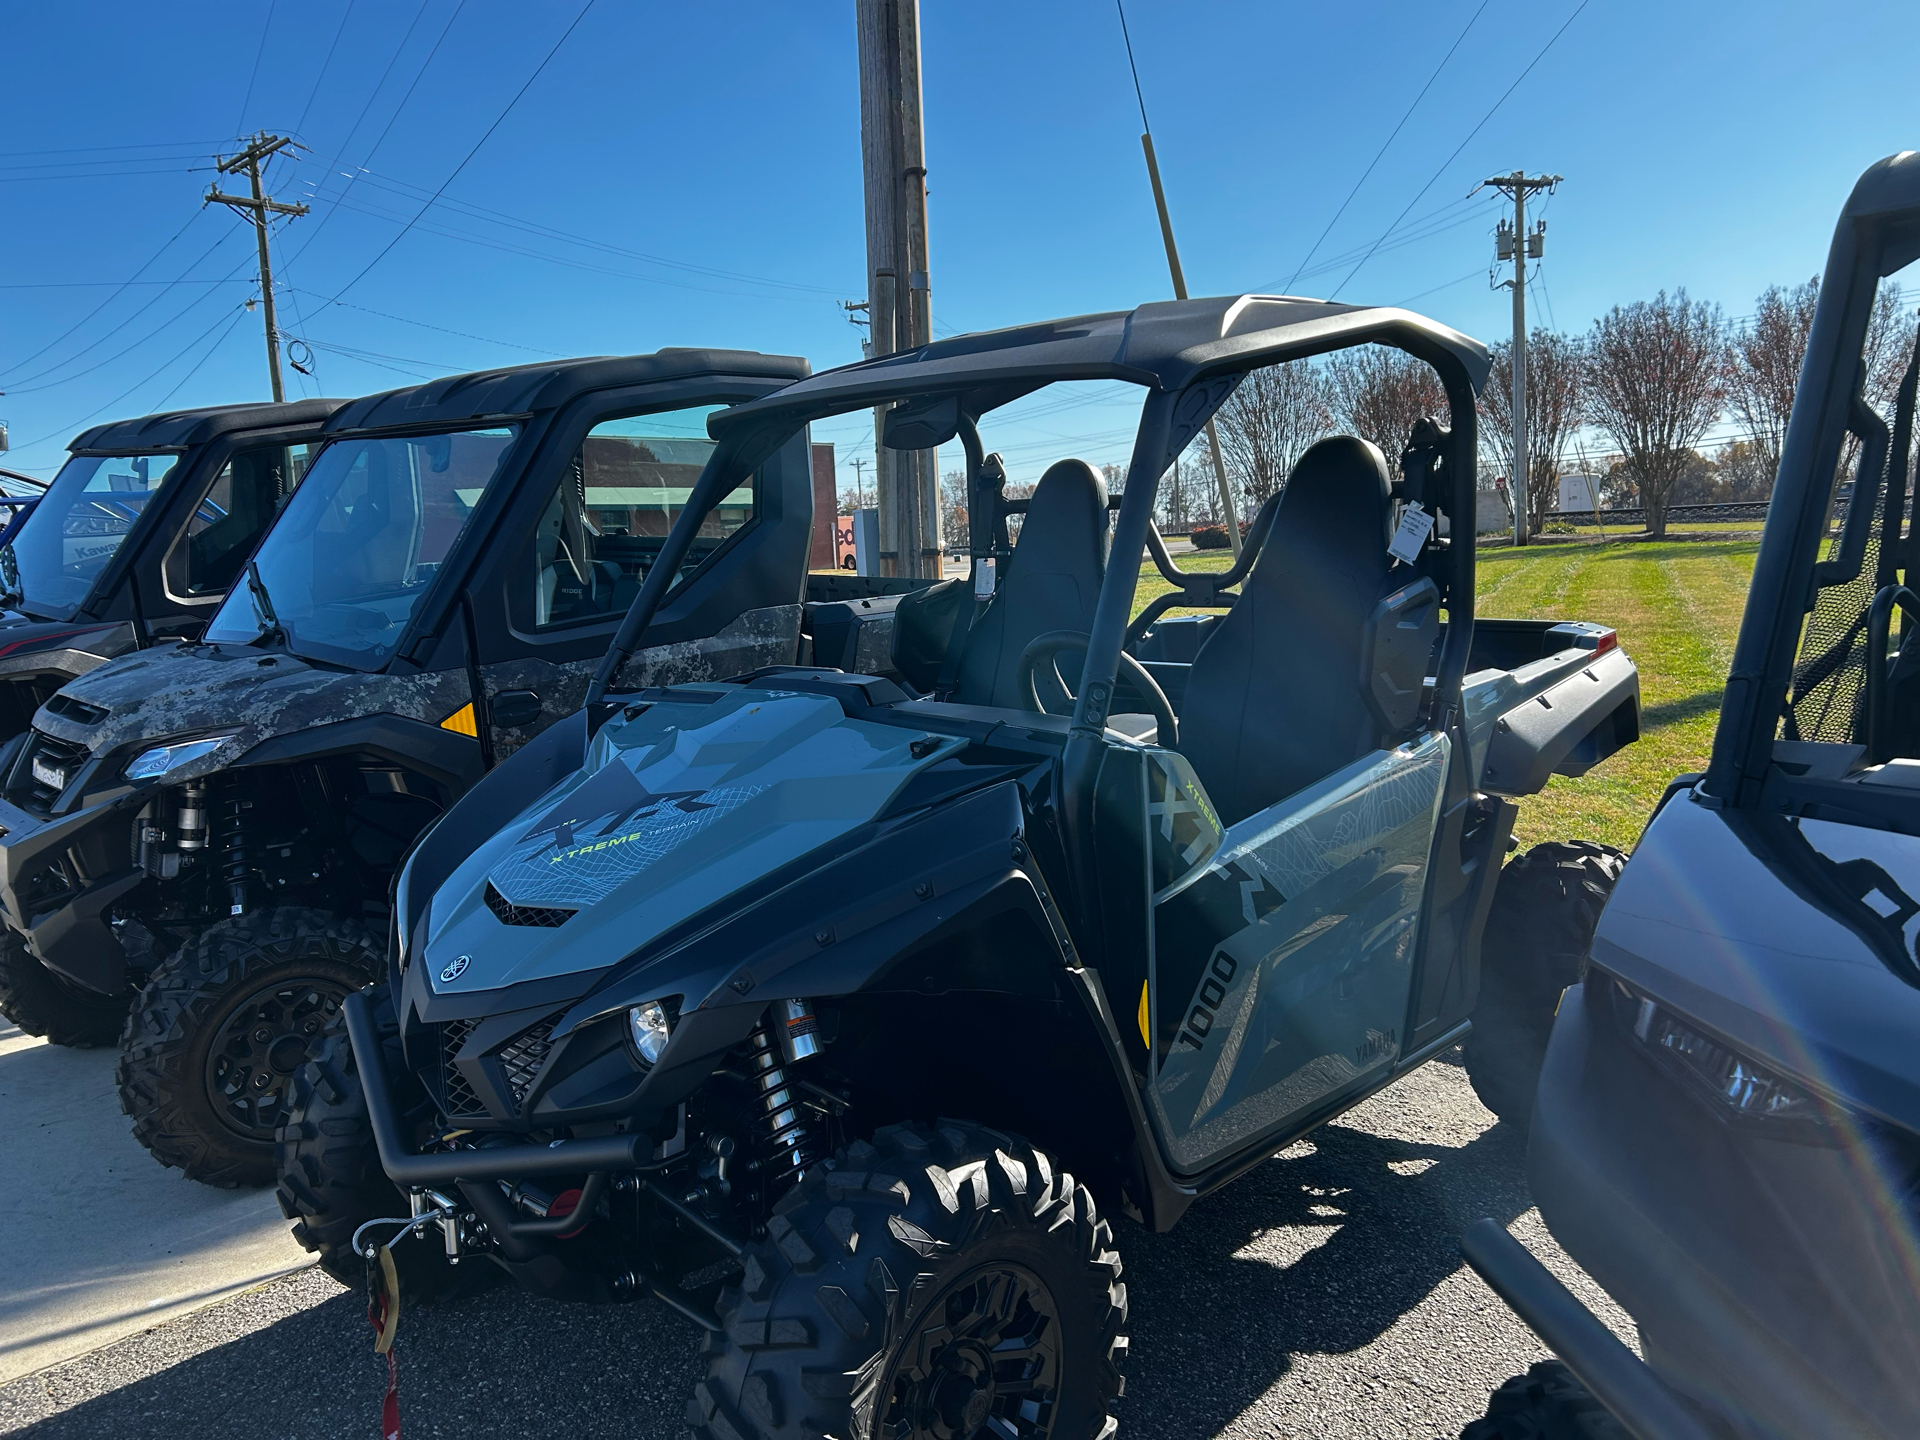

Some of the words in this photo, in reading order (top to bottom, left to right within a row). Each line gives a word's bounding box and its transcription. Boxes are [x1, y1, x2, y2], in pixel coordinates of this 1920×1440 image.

[1186, 779, 1221, 836] XTREME
[550, 832, 642, 865] XTREME
[649, 819, 699, 836] TERRAIN
[1236, 844, 1269, 871] TERRAIN
[1179, 949, 1238, 1052] 1000
[1356, 1029, 1396, 1064] YAMAHA
